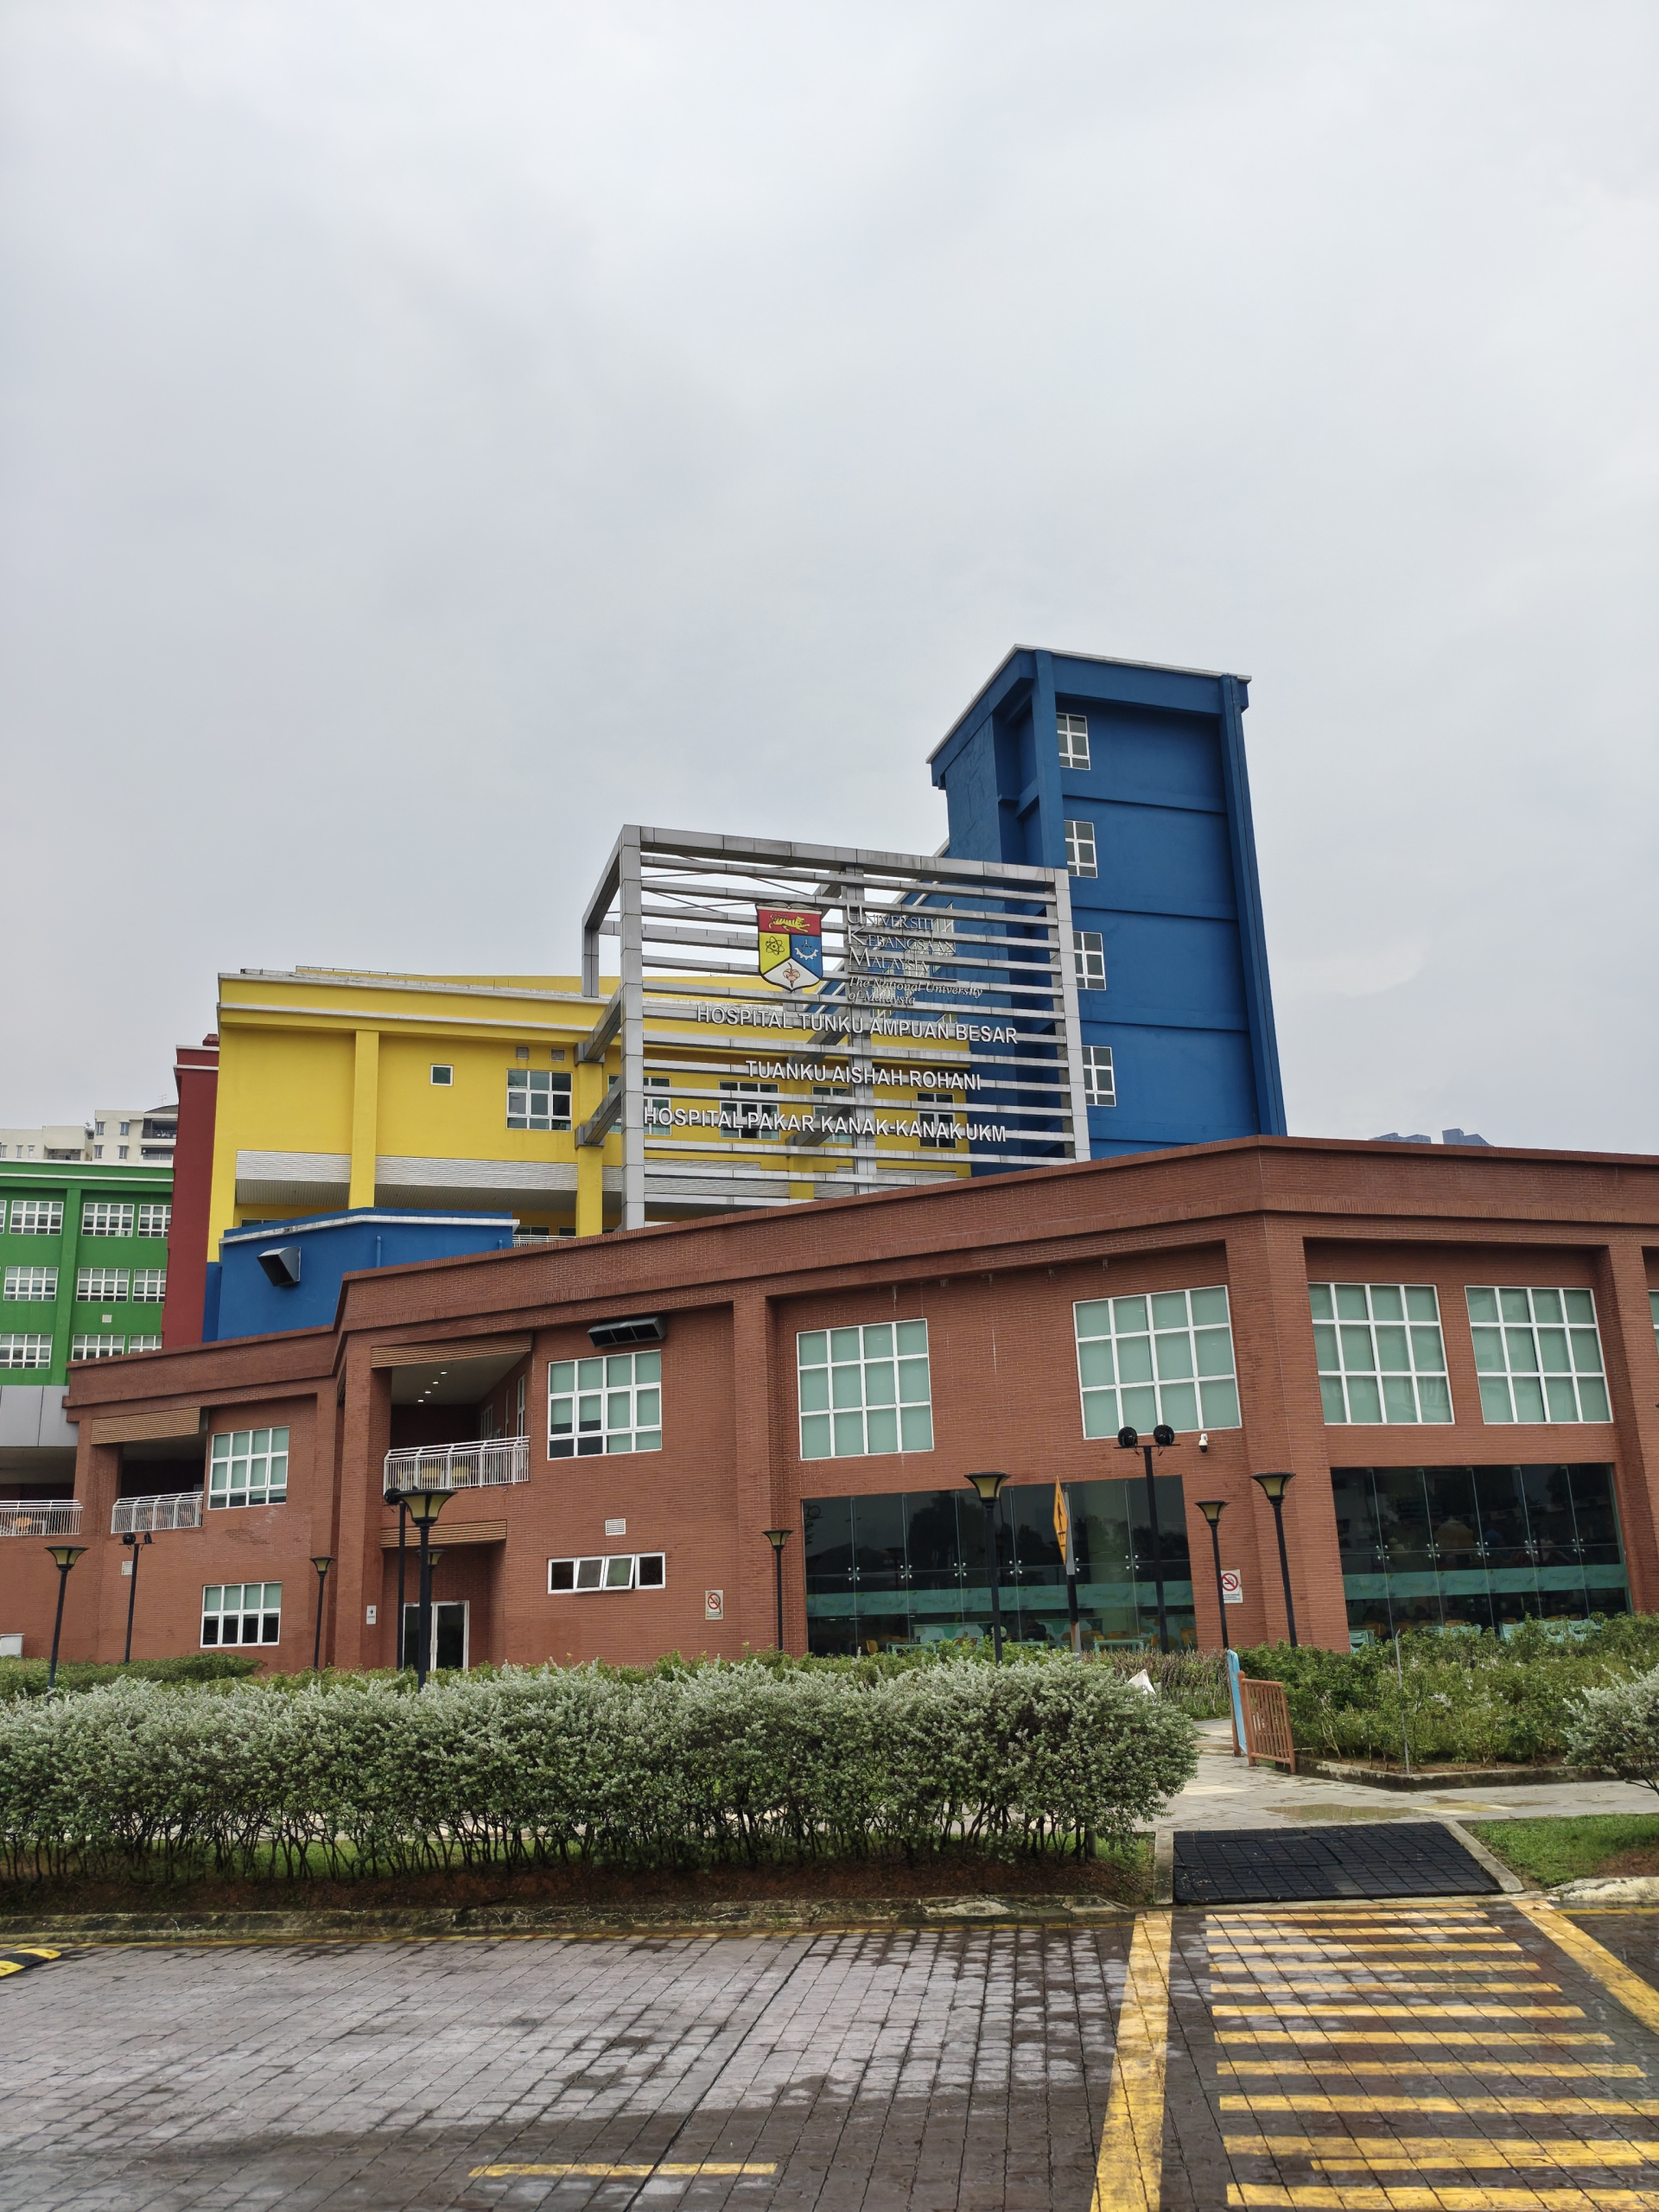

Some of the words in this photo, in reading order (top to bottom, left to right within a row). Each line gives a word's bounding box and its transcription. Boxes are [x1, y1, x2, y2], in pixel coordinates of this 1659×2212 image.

[846, 904, 934, 931] UNIVERSITI
[849, 946, 930, 973] MALAYSIA
[848, 990, 860, 1003] of
[863, 991, 916, 1007] Malaysia
[849, 976, 870, 988] The
[873, 977, 922, 993] National
[925, 982, 983, 999] University
[697, 1005, 793, 1030] HOSPITAL
[798, 1013, 864, 1034] TUNKU
[869, 1018, 950, 1040] AMPUAN
[956, 1024, 1019, 1045] BESAR
[745, 1060, 826, 1083] TUANKU
[832, 1065, 903, 1087] AISHAH
[909, 1070, 982, 1091] ROHANI
[644, 1106, 744, 1129] HOSPITAL
[747, 1111, 815, 1133] PAKAR
[822, 1115, 963, 1140] KANAK-KANAK
[965, 1123, 1007, 1143] UKM
